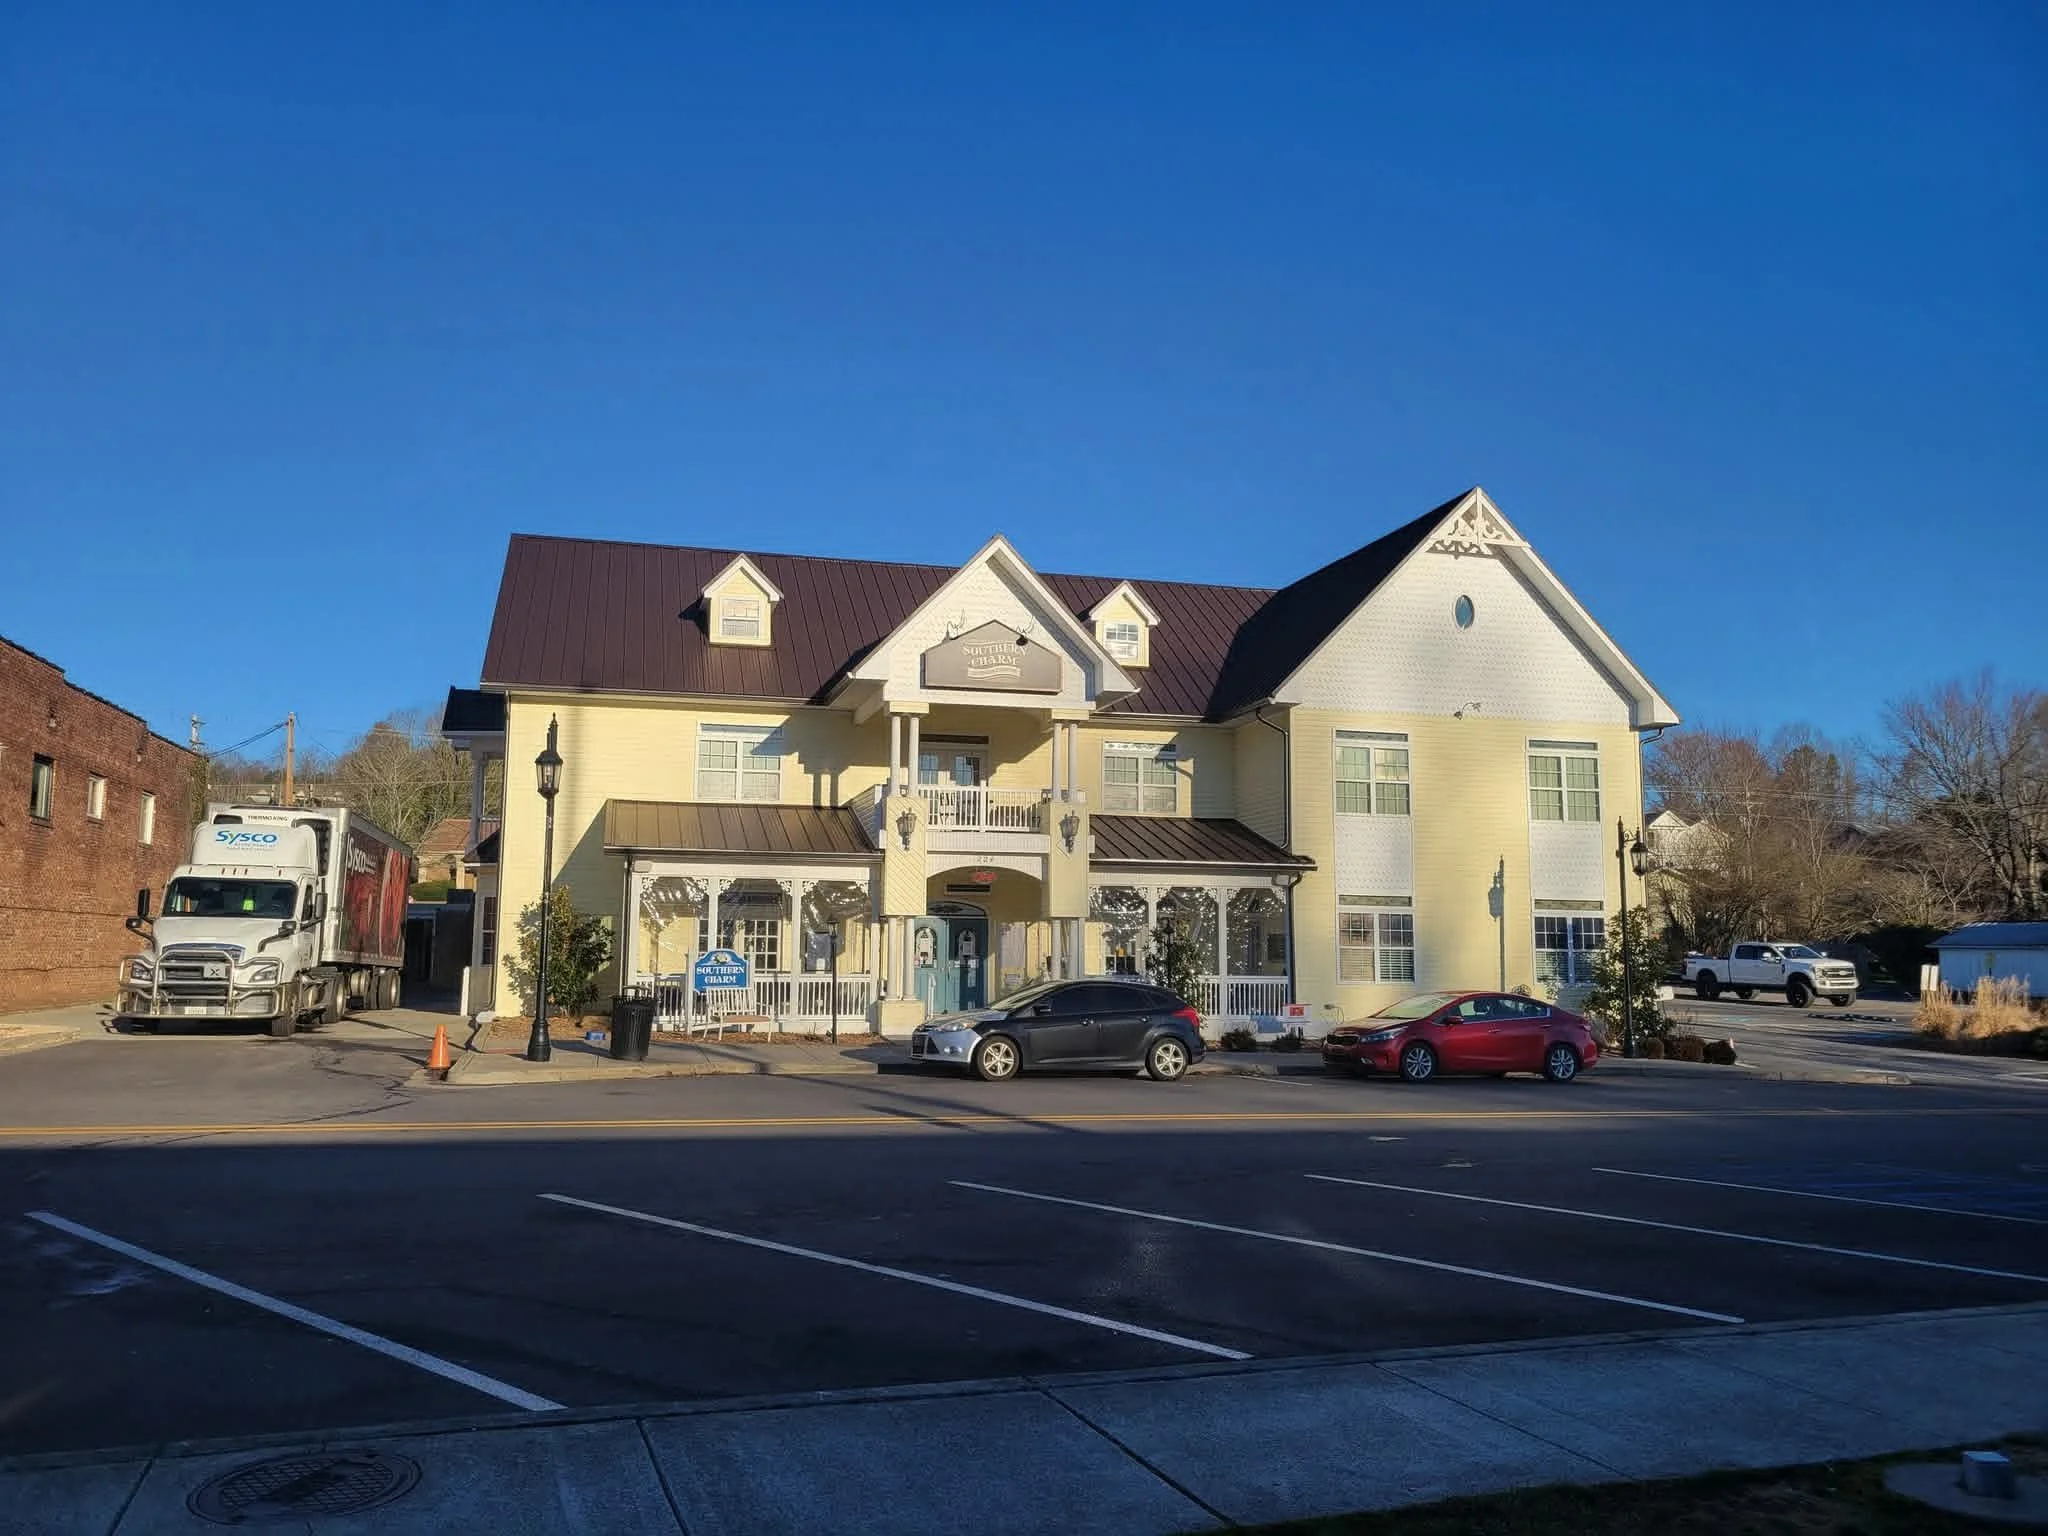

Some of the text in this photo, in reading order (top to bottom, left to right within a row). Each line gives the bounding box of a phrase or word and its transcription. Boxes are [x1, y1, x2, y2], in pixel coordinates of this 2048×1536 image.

[963, 643, 1027, 657] SOUTHERN
[969, 656, 1017, 665] CHARM
[696, 966, 744, 975] SOUTHERN
[704, 976, 736, 984] CHARM
